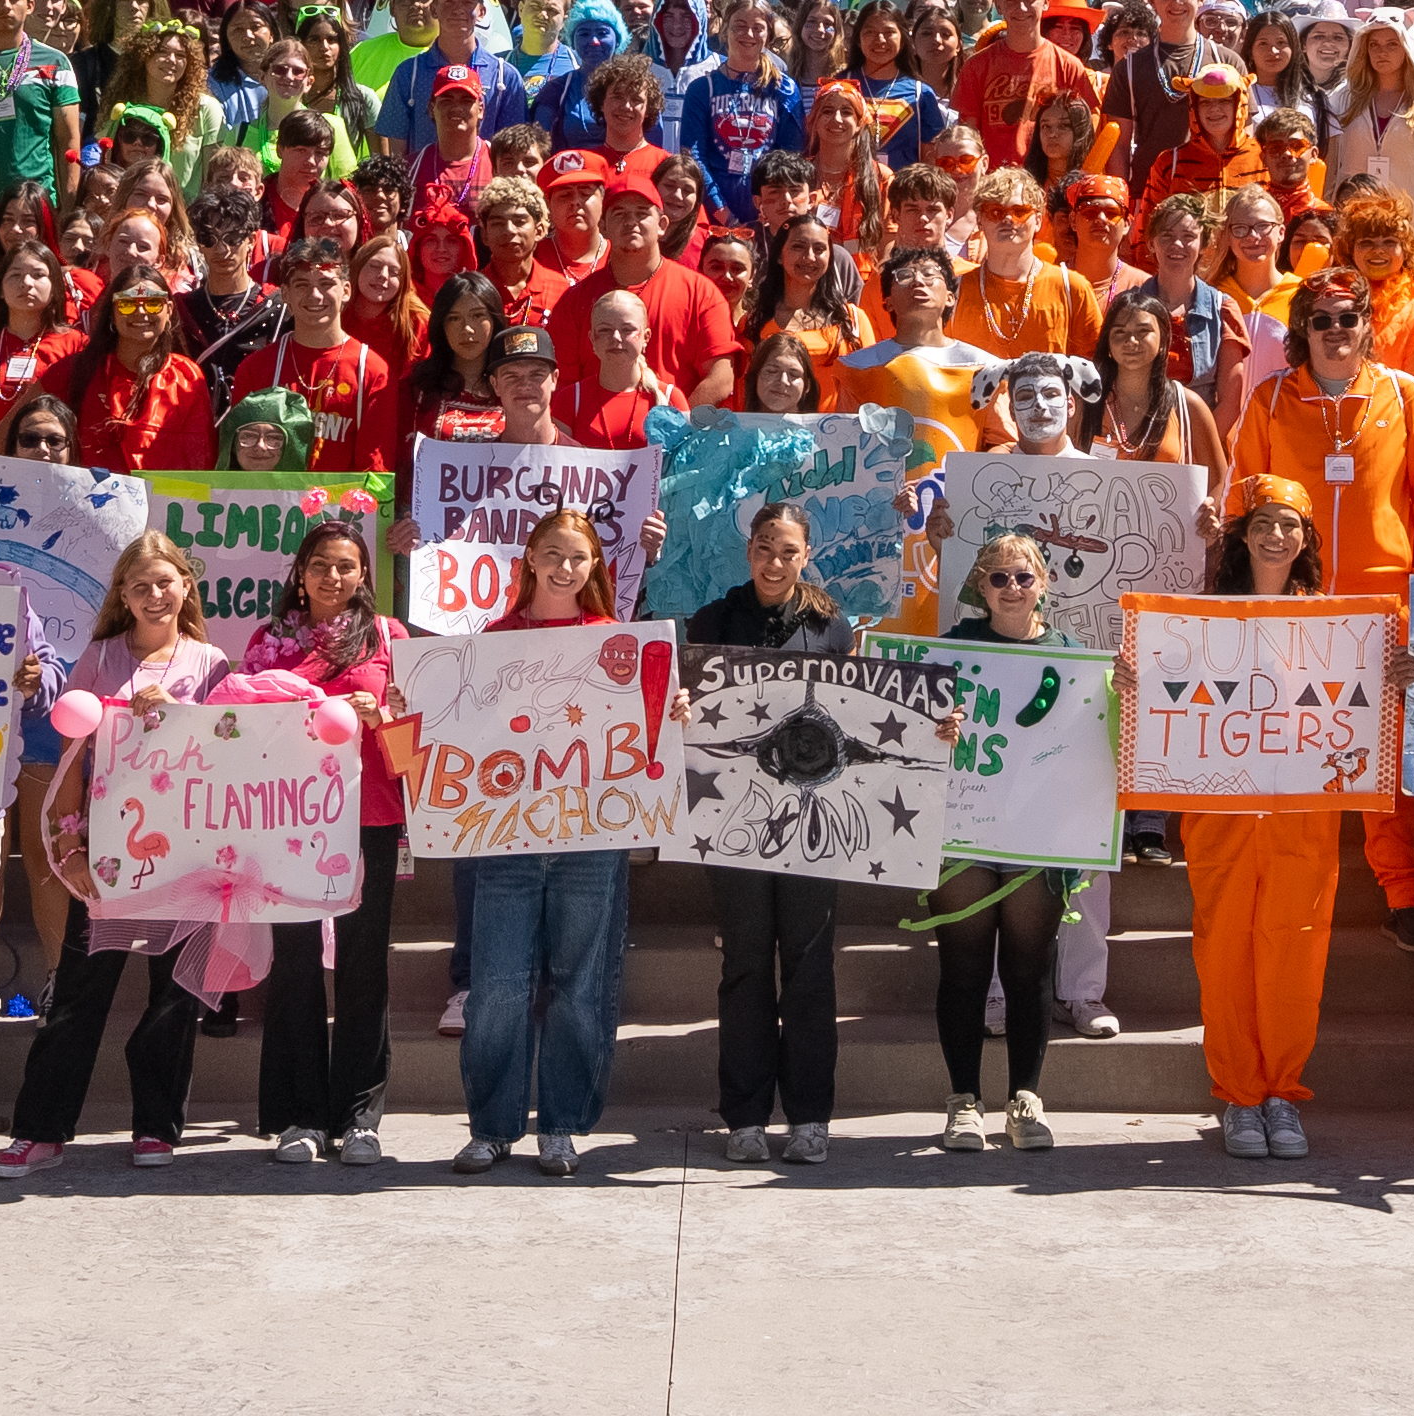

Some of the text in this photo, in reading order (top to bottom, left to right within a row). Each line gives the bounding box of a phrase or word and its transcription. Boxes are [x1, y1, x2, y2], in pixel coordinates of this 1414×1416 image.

[439, 463, 638, 505] BURGUNDY
[166, 502, 364, 556] LIMEA
[444, 506, 625, 547] BANDS
[876, 639, 930, 663] THE
[1152, 615, 1378, 676] SUNNY
[404, 639, 642, 732] Cherry
[105, 712, 216, 776] Pink
[1149, 705, 1355, 759] TIGERS
[184, 774, 345, 831] FLAMINGO
